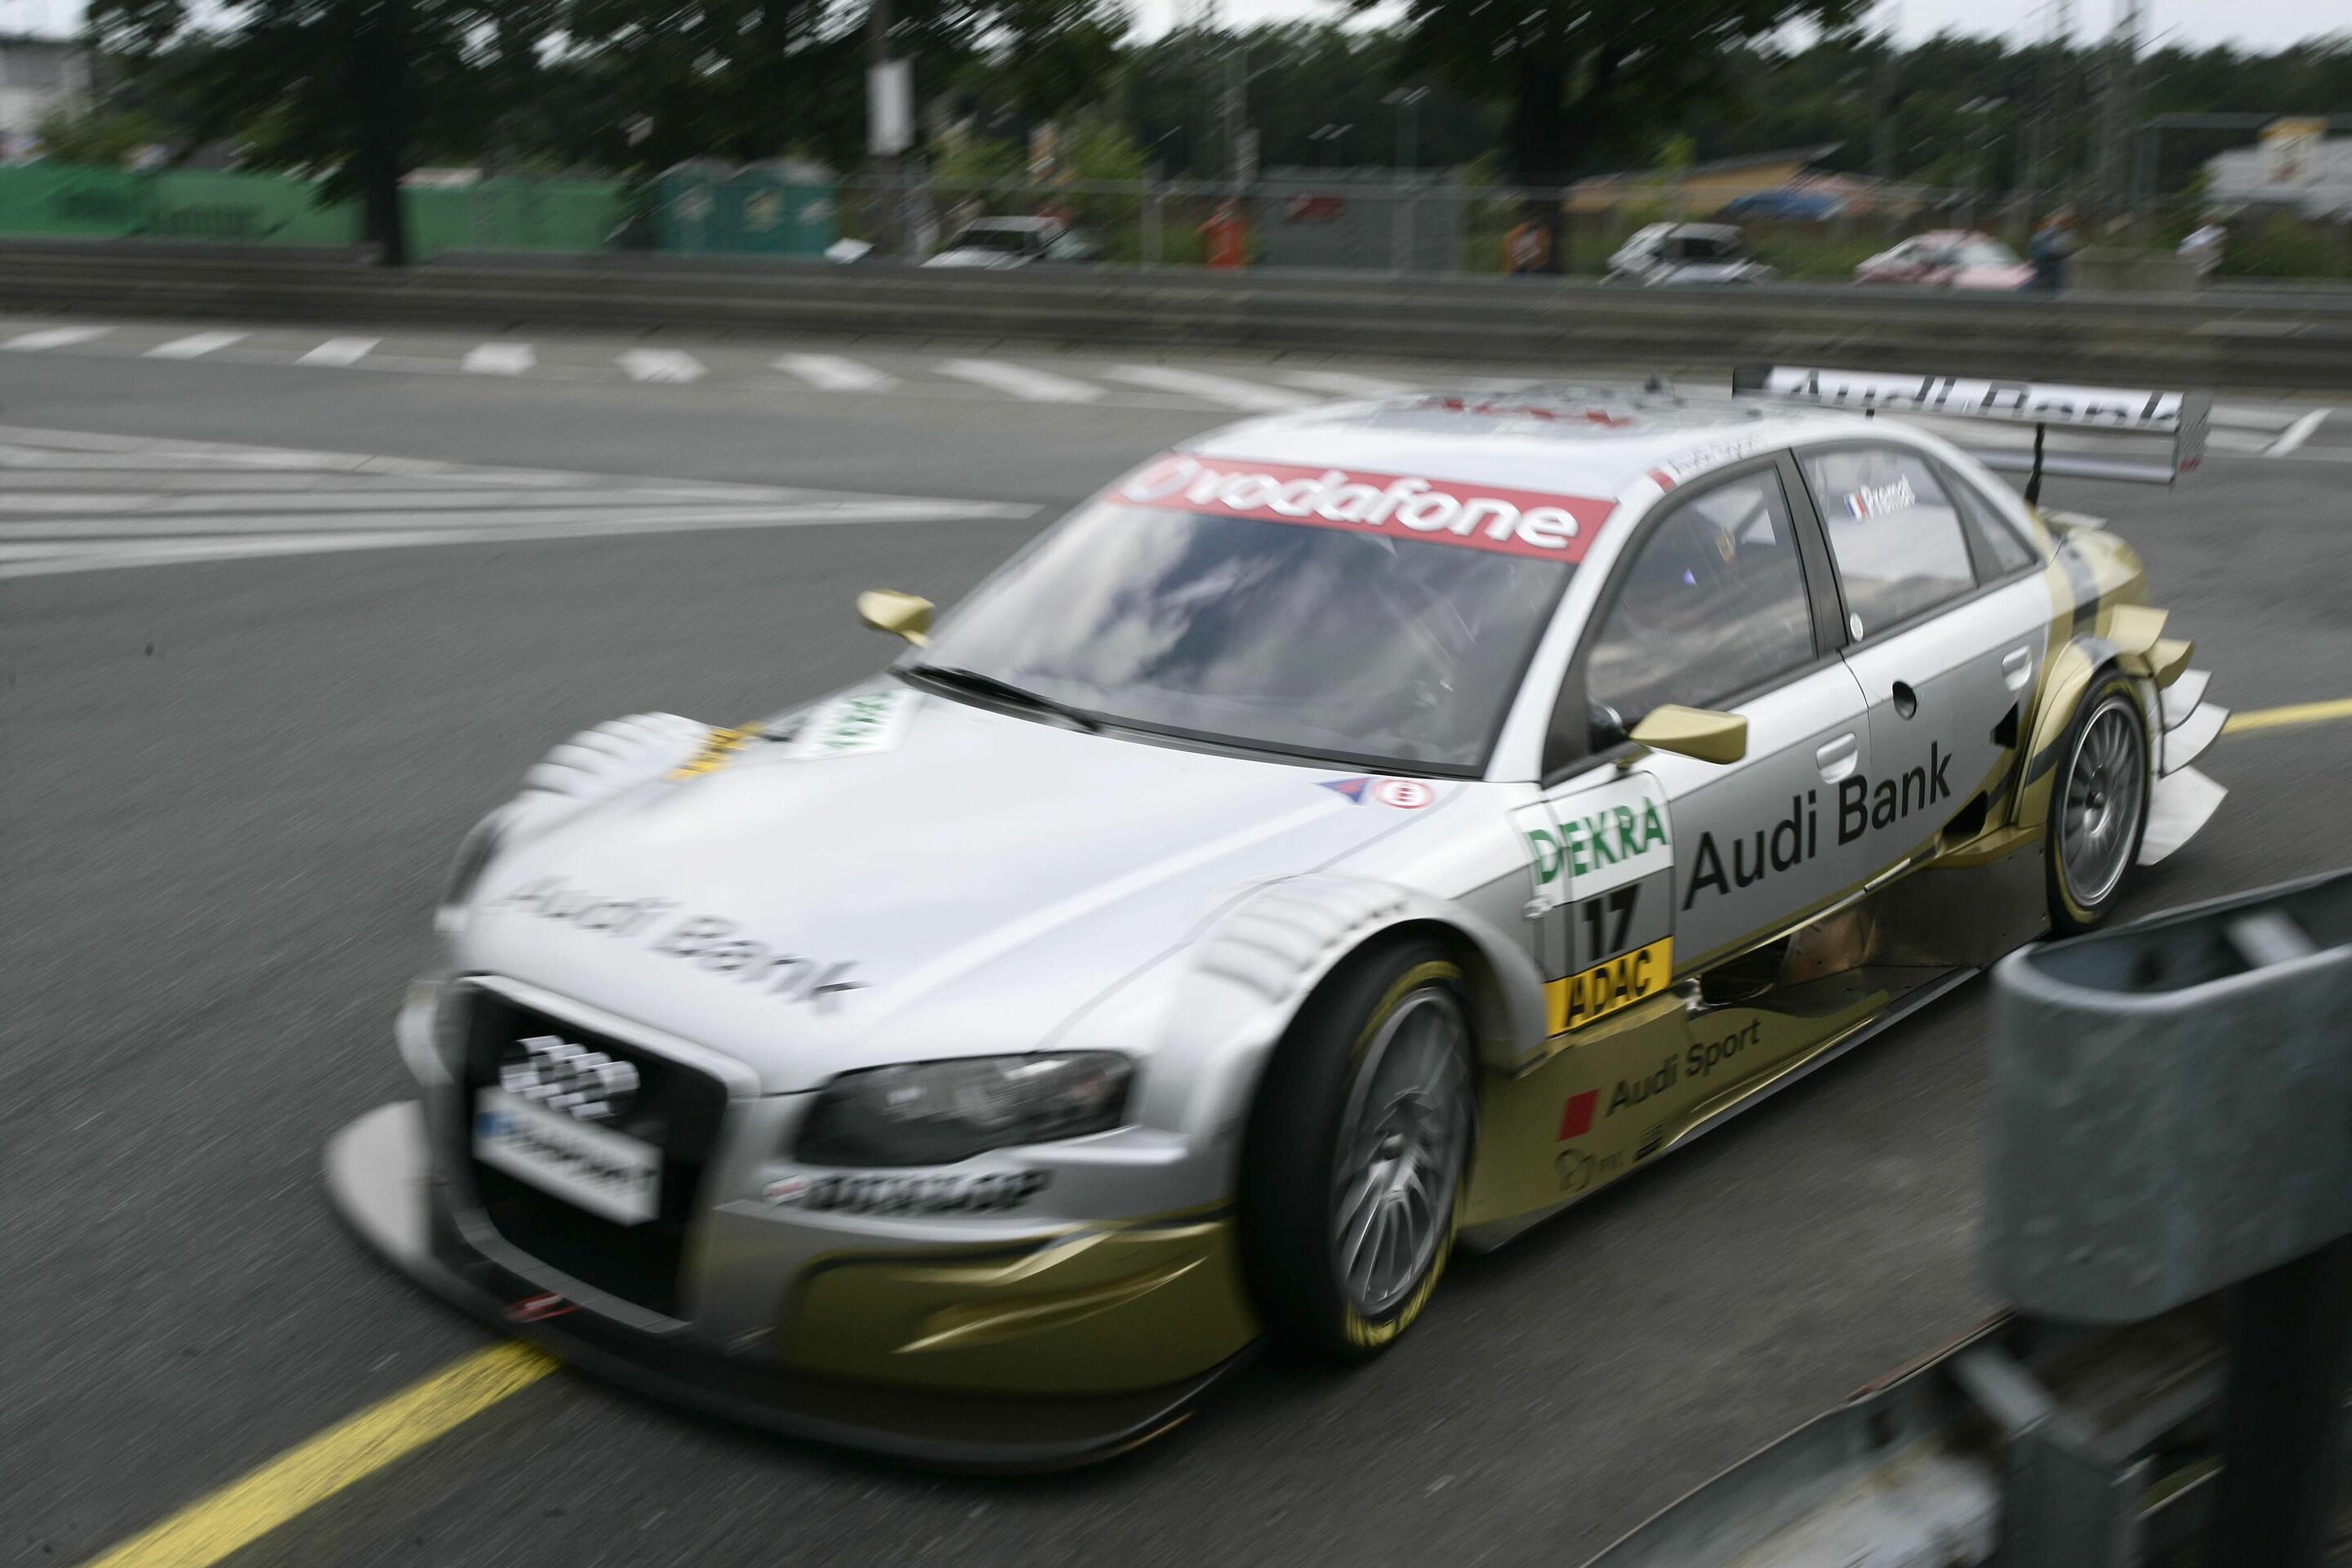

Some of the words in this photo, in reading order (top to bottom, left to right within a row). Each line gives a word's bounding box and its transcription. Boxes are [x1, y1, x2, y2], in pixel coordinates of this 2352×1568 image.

[1183, 468, 1579, 549] vodafone
[1527, 795, 1672, 885] DEKRA
[1682, 789, 1817, 911] Audi
[1838, 741, 1953, 846] Bank
[1583, 882, 1642, 962] 17
[1561, 949, 1652, 1029] ADAC
[1605, 1054, 1679, 1117] Audi
[1684, 1018, 1761, 1078] Sport
